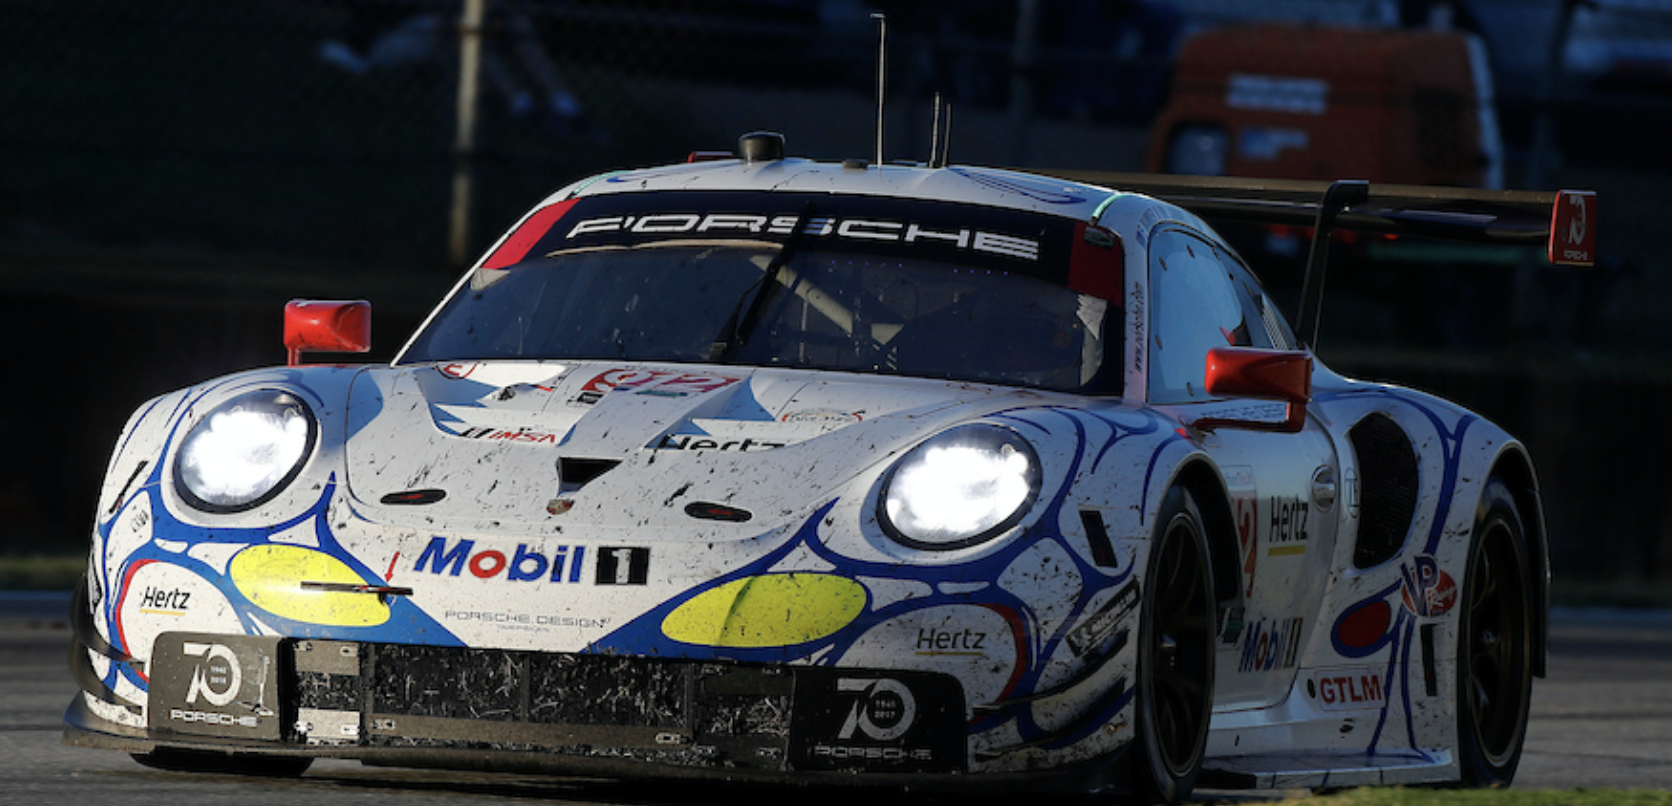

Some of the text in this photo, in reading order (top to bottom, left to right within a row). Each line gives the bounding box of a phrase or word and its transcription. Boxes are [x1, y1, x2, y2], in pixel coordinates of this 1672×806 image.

[566, 213, 1040, 261] PORSCHE
[1268, 495, 1309, 543] Hertz
[412, 536, 586, 583] Mobil
[141, 586, 190, 611] Hertz
[1401, 556, 1438, 617] VP
[445, 610, 531, 624] PORSCHE
[916, 628, 987, 650] Hertz
[1238, 618, 1292, 672] Mobil
[183, 641, 242, 706] 70
[1320, 674, 1382, 704] GTLM
[170, 708, 257, 728] PORSCHE
[837, 678, 917, 741] 70
